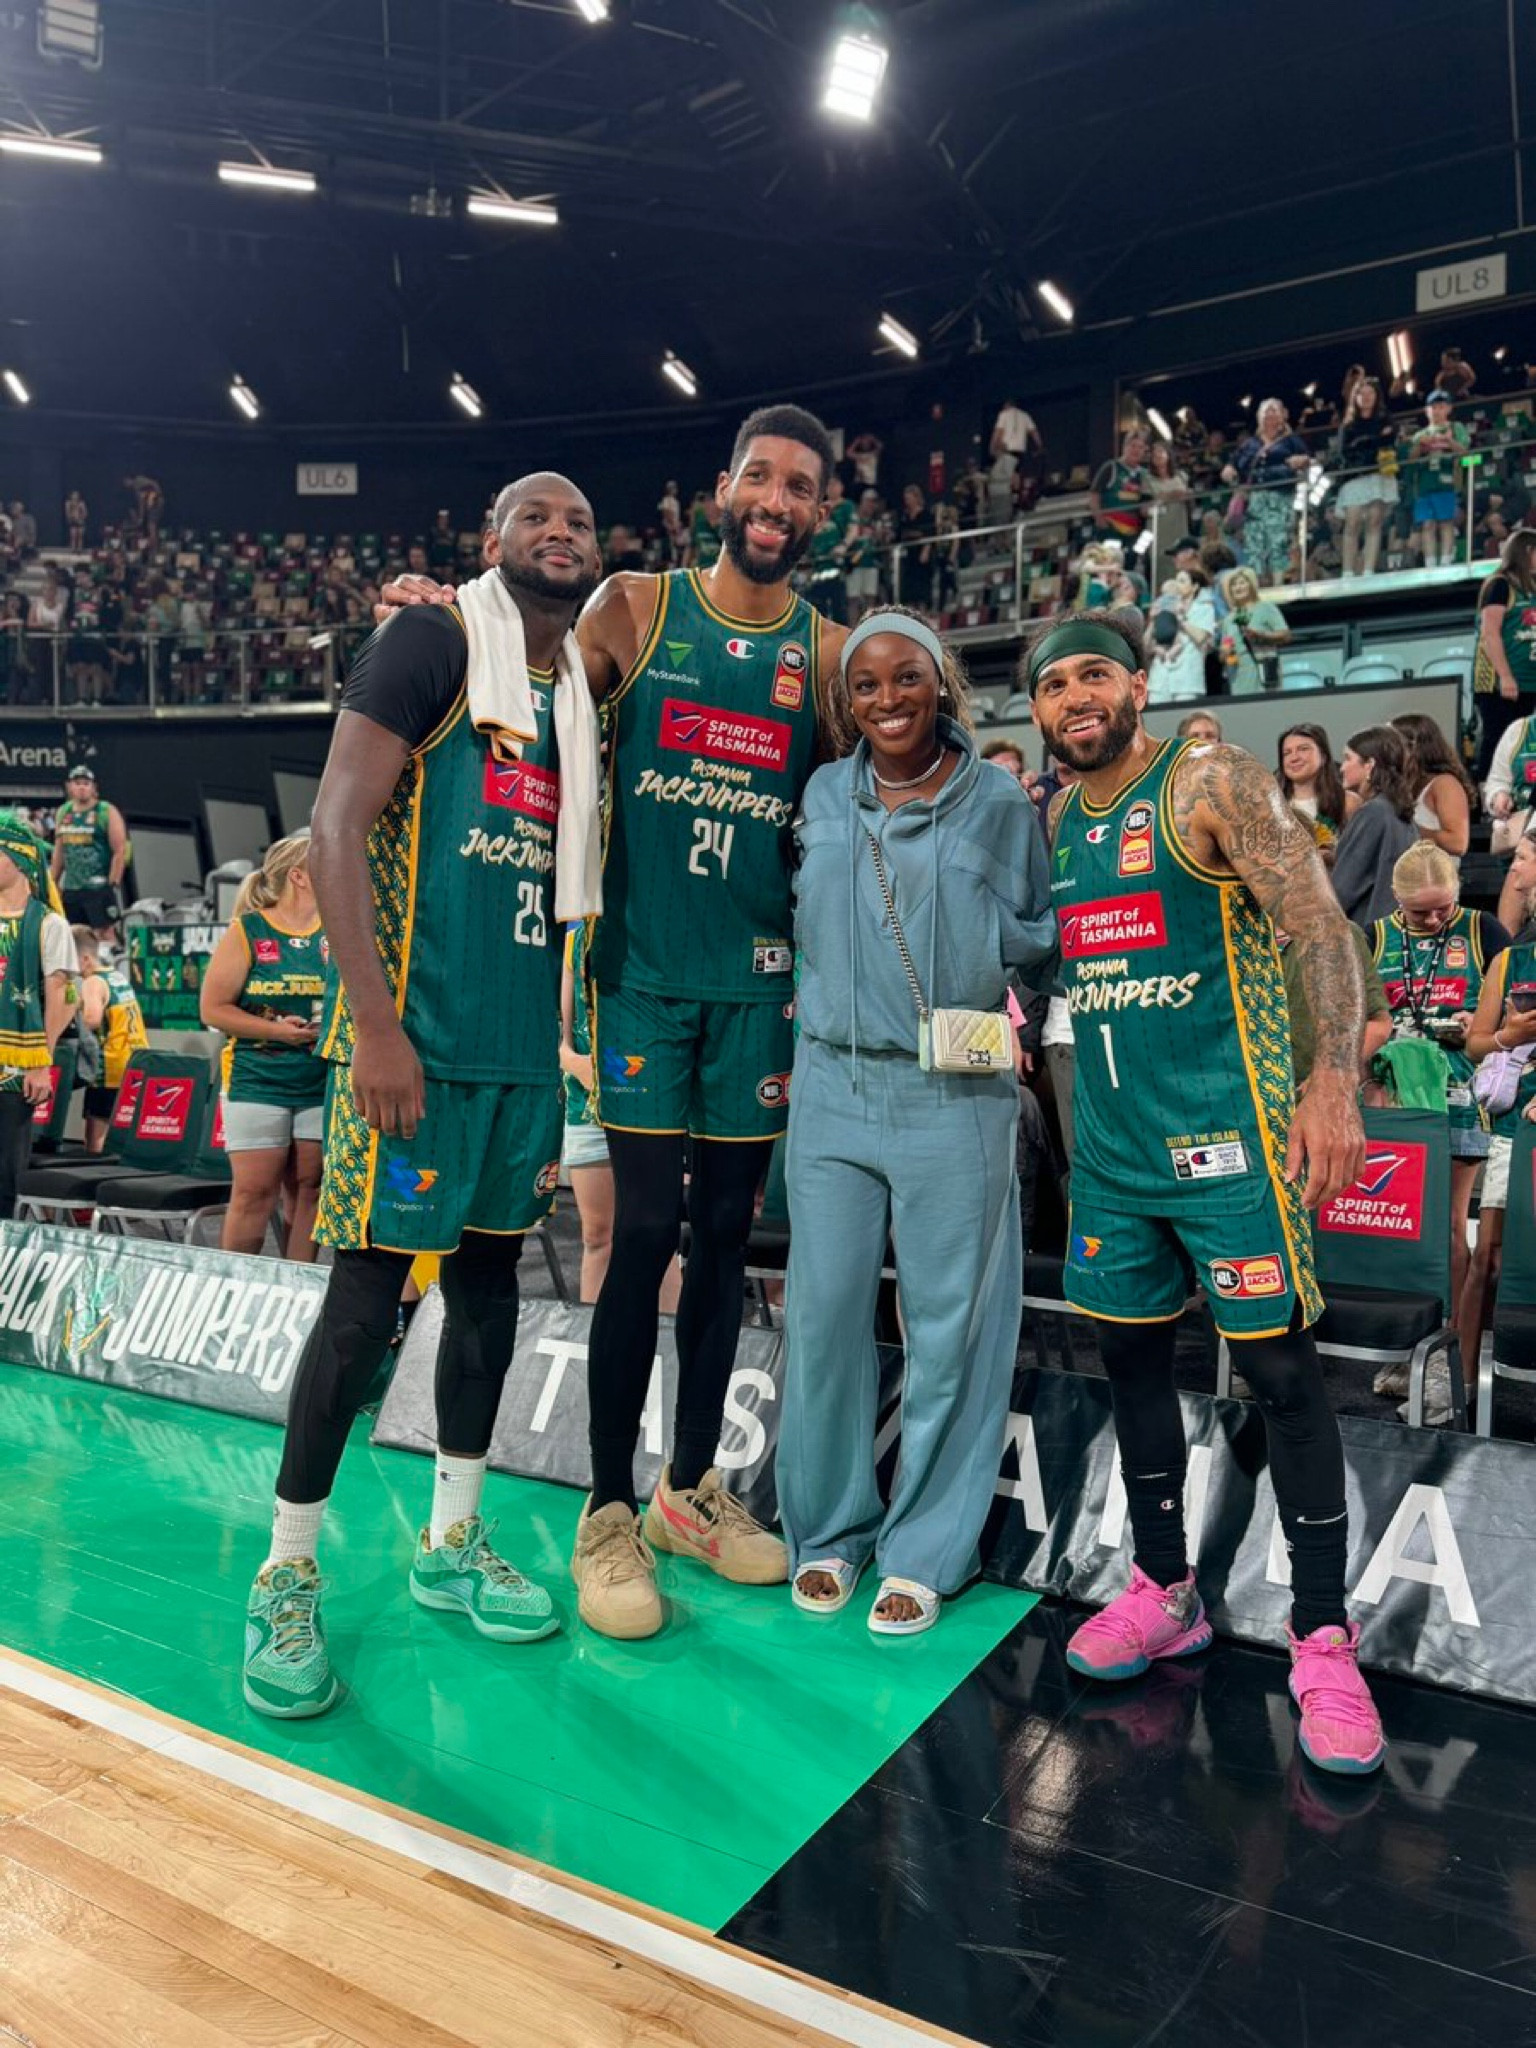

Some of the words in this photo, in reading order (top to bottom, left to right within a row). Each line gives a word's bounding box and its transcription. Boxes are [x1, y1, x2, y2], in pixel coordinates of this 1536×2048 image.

[1432, 267, 1488, 299] UL8
[305, 469, 349, 489] UL6
[707, 719, 759, 740] SPIRIT
[759, 731, 774, 744] of
[0, 742, 67, 767] Arena
[704, 733, 781, 762] TASMANIA
[634, 769, 793, 827] JACKJUMPERS
[688, 816, 735, 880] 24
[514, 880, 547, 947] 25
[1080, 909, 1123, 930] SPIRIT
[1123, 907, 1140, 923] of
[1080, 921, 1158, 945] TASMANIA
[1099, 1023, 1120, 1089] 1
[1334, 1197, 1389, 1214] SPIRIT
[1389, 1203, 1407, 1215] of
[1326, 1209, 1413, 1231] TASMANIA
[0, 1246, 85, 1336] ACK
[103, 1267, 323, 1393] JUMPERS
